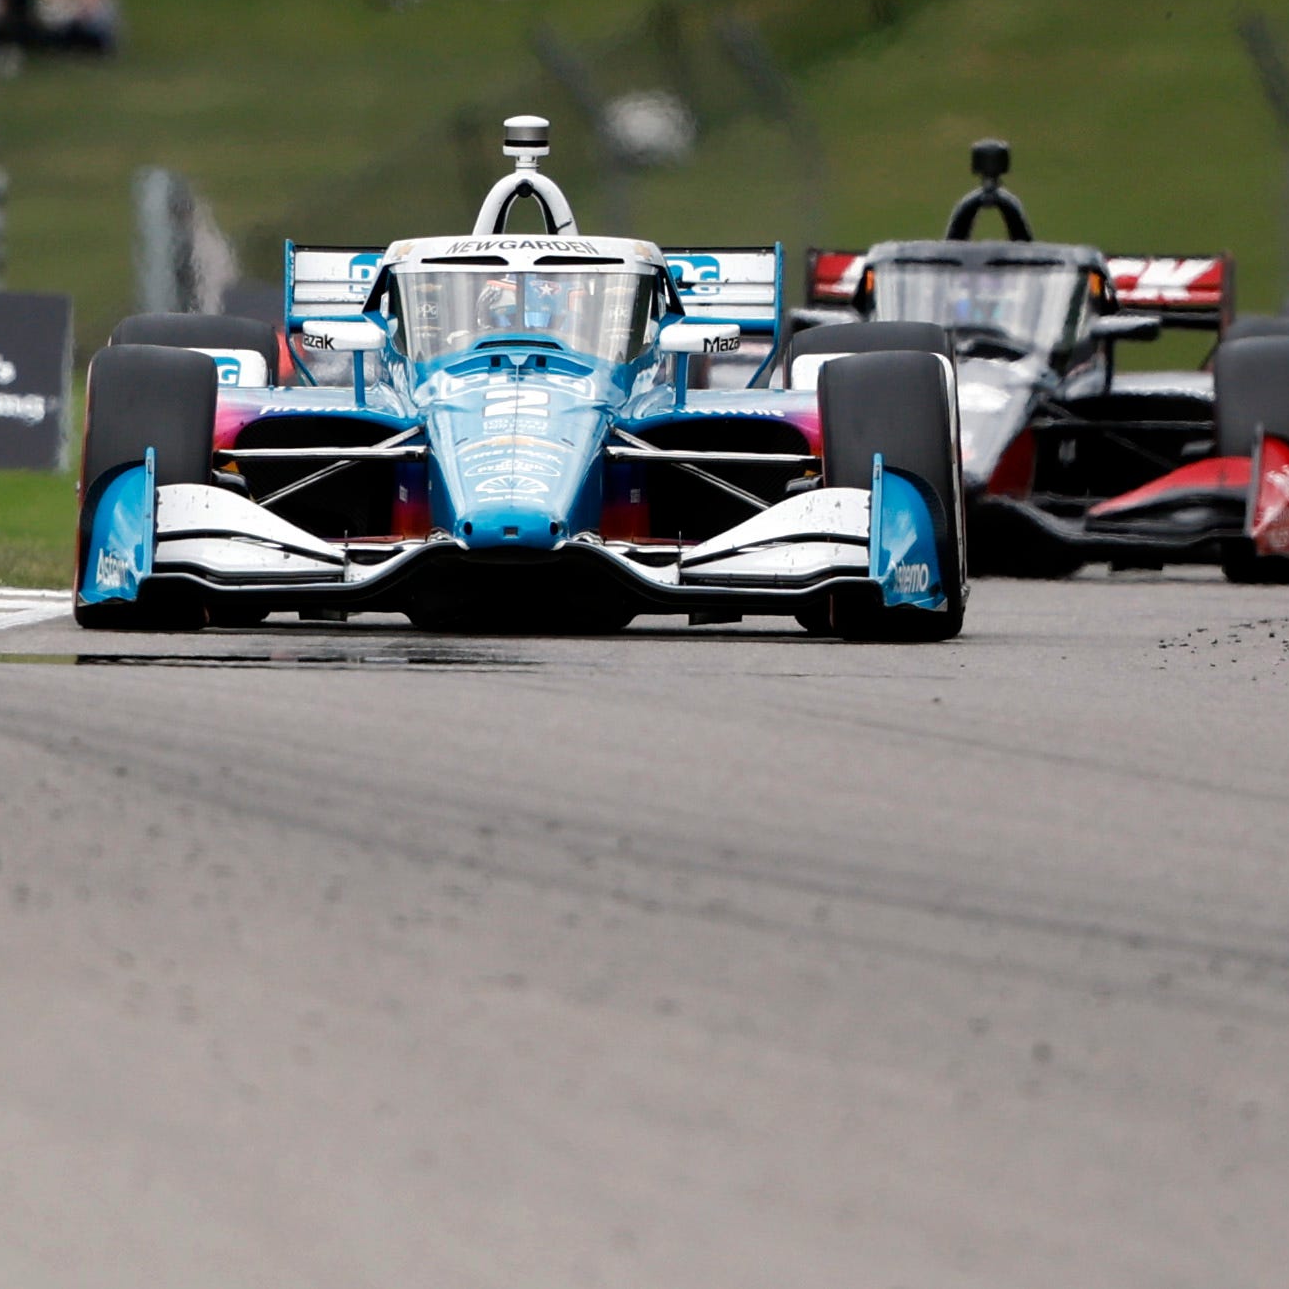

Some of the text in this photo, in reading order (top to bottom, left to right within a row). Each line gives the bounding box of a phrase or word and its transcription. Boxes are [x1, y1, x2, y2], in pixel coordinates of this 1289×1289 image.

[445, 240, 599, 256] NEWGARDEN
[303, 334, 335, 350] azak
[704, 336, 740, 353] Maza
[483, 390, 550, 418] 2
